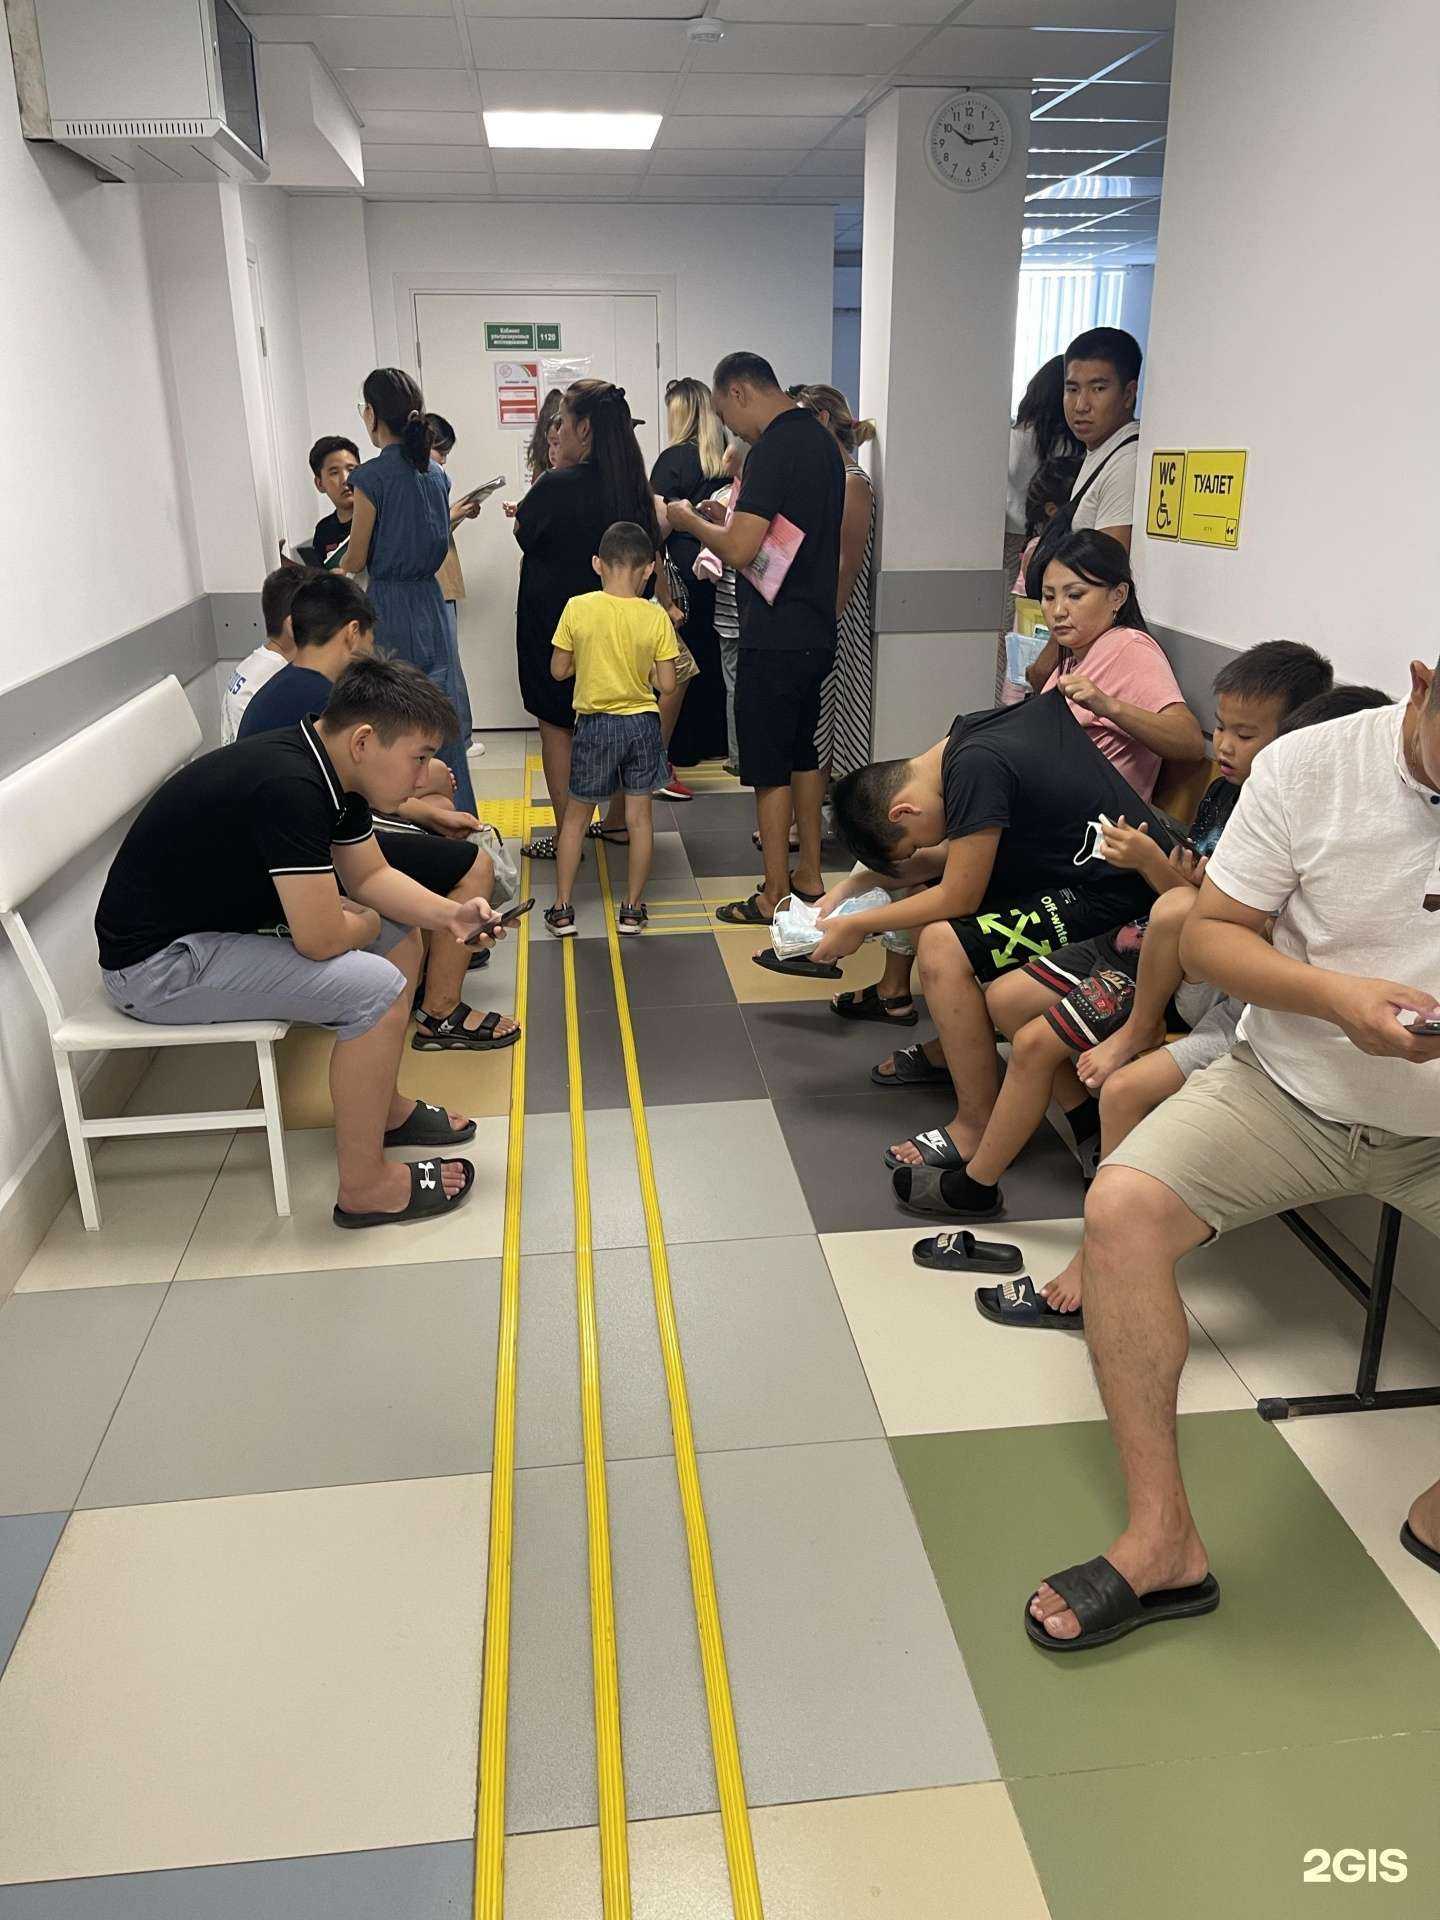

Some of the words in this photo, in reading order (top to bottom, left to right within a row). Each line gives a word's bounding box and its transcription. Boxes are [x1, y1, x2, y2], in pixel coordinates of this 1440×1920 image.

[953, 111, 961, 121] 11
[965, 107, 974, 117] 12
[944, 123, 952, 133] 10
[988, 121, 995, 131] 2
[939, 138, 945, 148] 9
[943, 152, 949, 162] 8
[988, 149, 995, 159] 4
[965, 167, 971, 177] 6
[981, 162, 986, 172] 5
[1159, 462, 1176, 485] WC
[1194, 474, 1234, 495] ТУАЛЕТ
